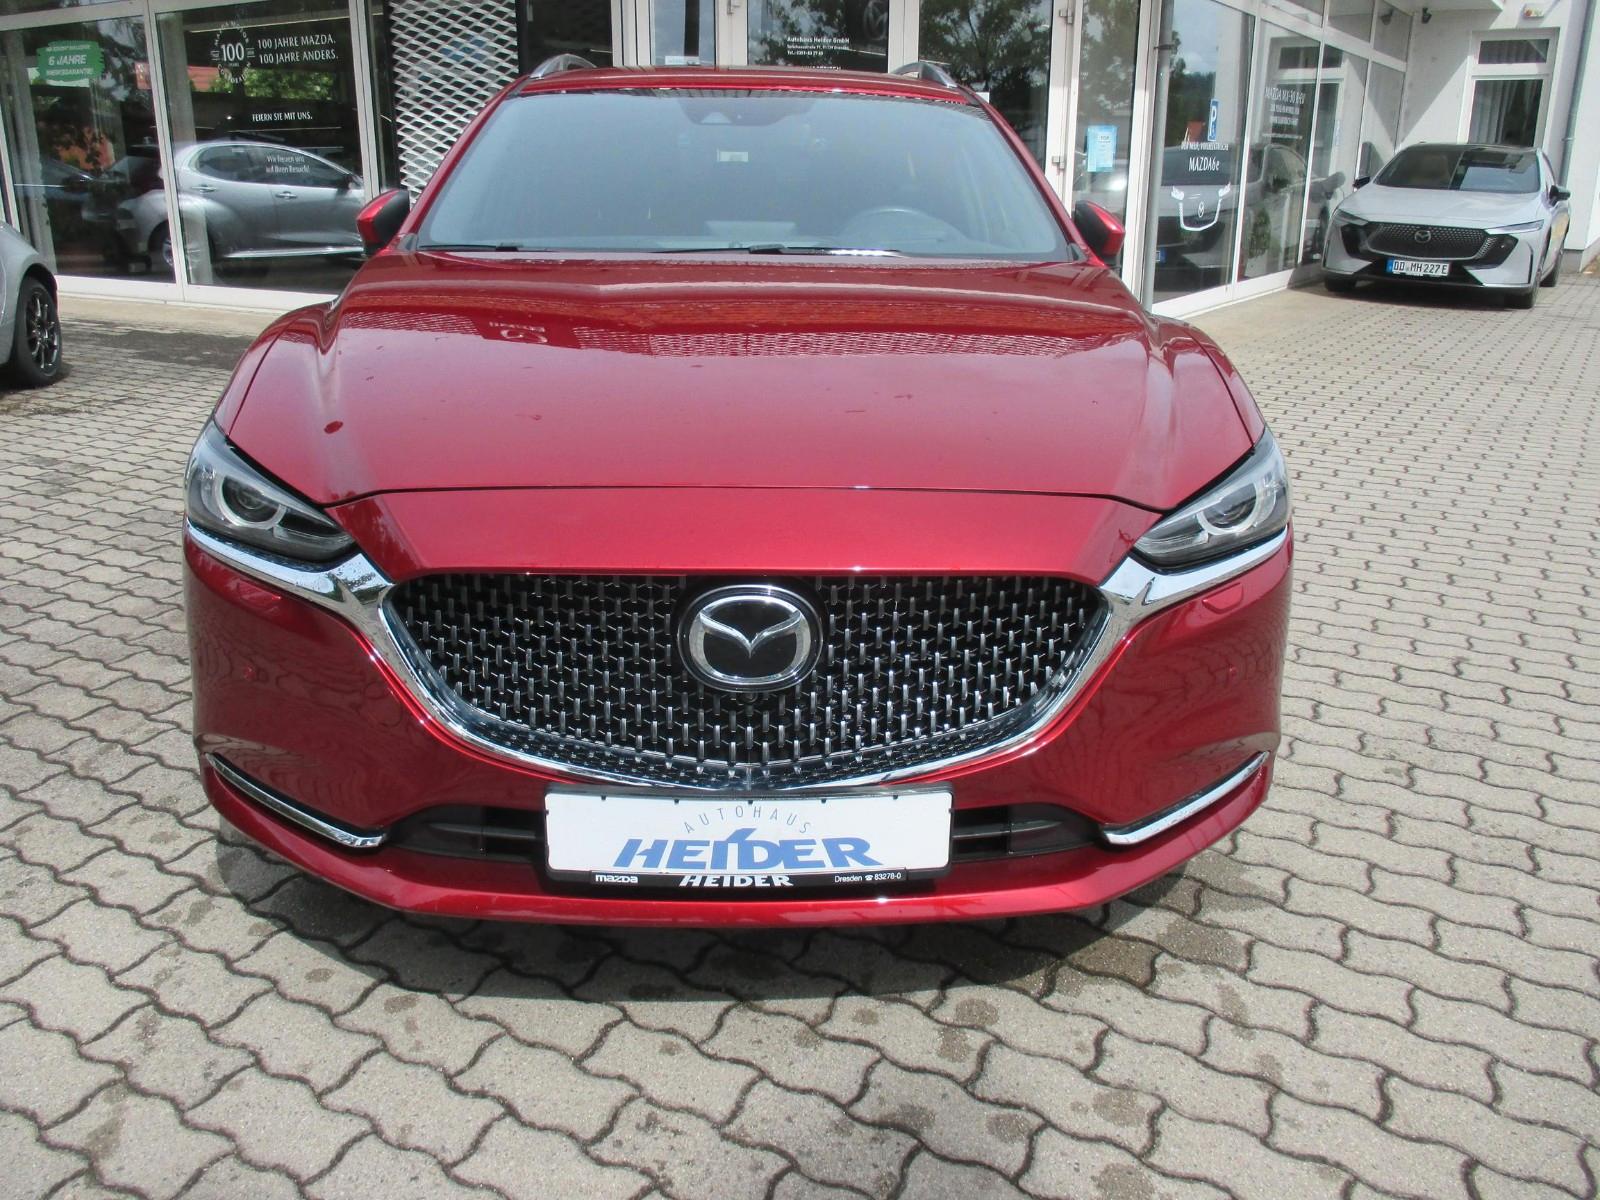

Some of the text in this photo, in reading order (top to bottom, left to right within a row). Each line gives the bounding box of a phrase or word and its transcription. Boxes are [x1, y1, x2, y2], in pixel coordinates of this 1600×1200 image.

[258, 33, 336, 49] 100 JAHRE MAZDA.
[833, 36, 850, 44] GmbH
[48, 54, 88, 66] 6 JAHRE
[220, 42, 245, 62] 100
[259, 53, 274, 65] 100
[275, 51, 301, 65] JAHRE
[302, 48, 339, 61] ANDERS.
[252, 111, 313, 122] FEIERN SIE MIT UNS.
[1394, 261, 1406, 272] DD
[1410, 262, 1423, 273] MH
[683, 805, 812, 835] AUTOHAUS
[613, 828, 883, 871] HEIDER
[595, 872, 902, 888] mazda HEIDER Dresden 83278-0
